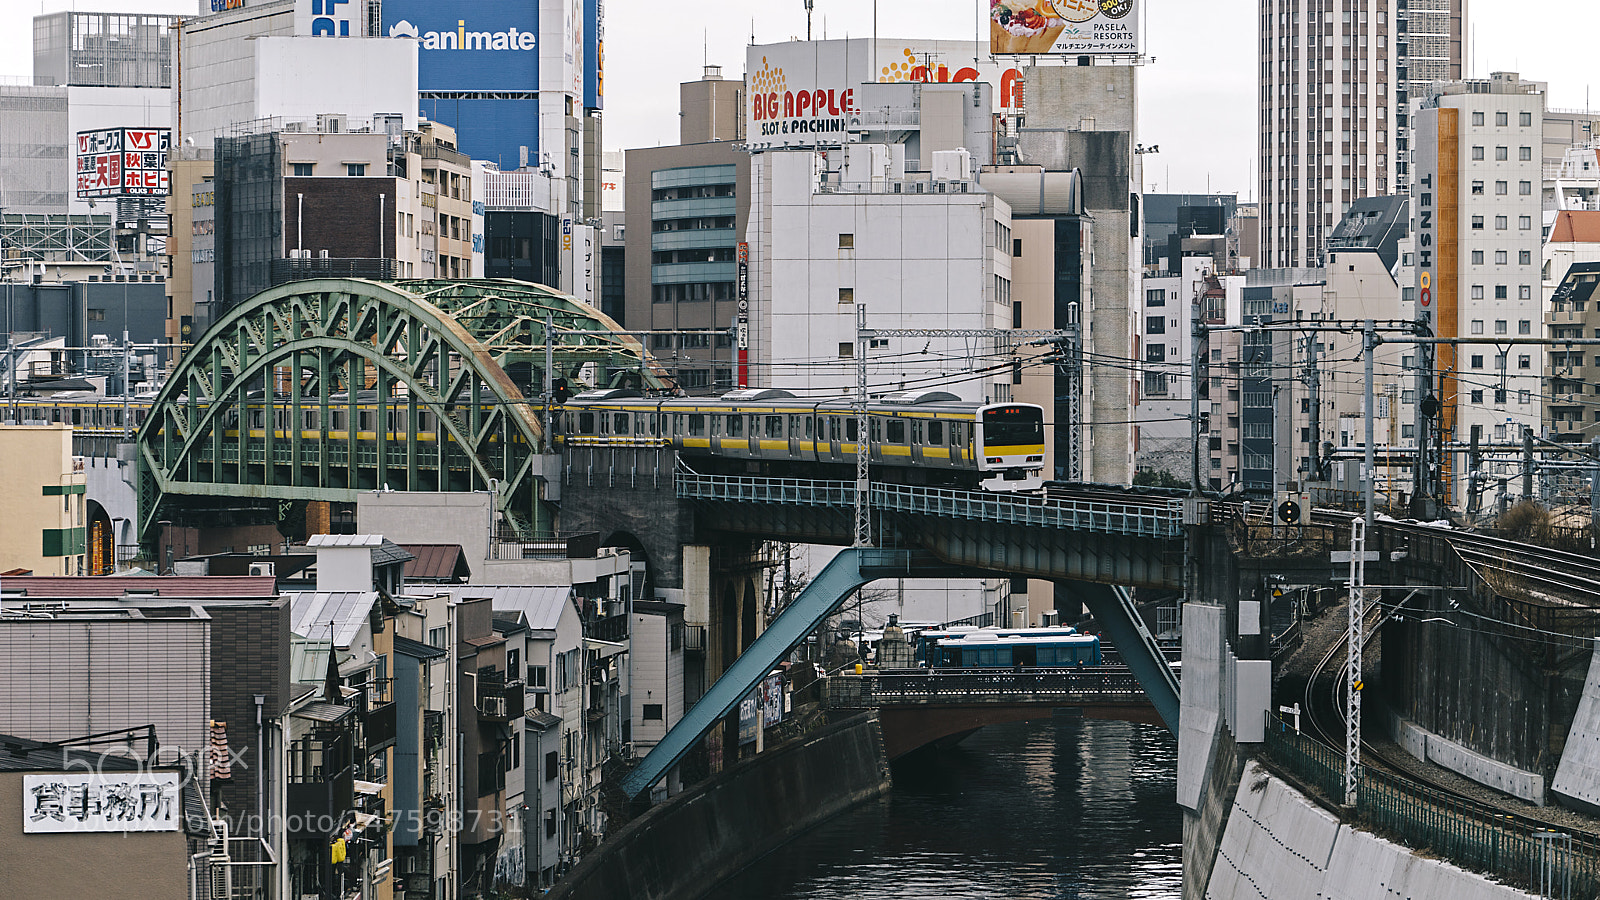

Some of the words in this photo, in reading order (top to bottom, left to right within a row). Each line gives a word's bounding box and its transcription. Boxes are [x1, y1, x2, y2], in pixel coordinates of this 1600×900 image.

[423, 20, 536, 50] animate
[1093, 23, 1127, 31] PASELA
[1093, 32, 1133, 40] RESORTS
[754, 92, 779, 120] BIG
[761, 121, 780, 136] SLOT
[781, 120, 789, 134] &
[90, 131, 120, 153] ボークス
